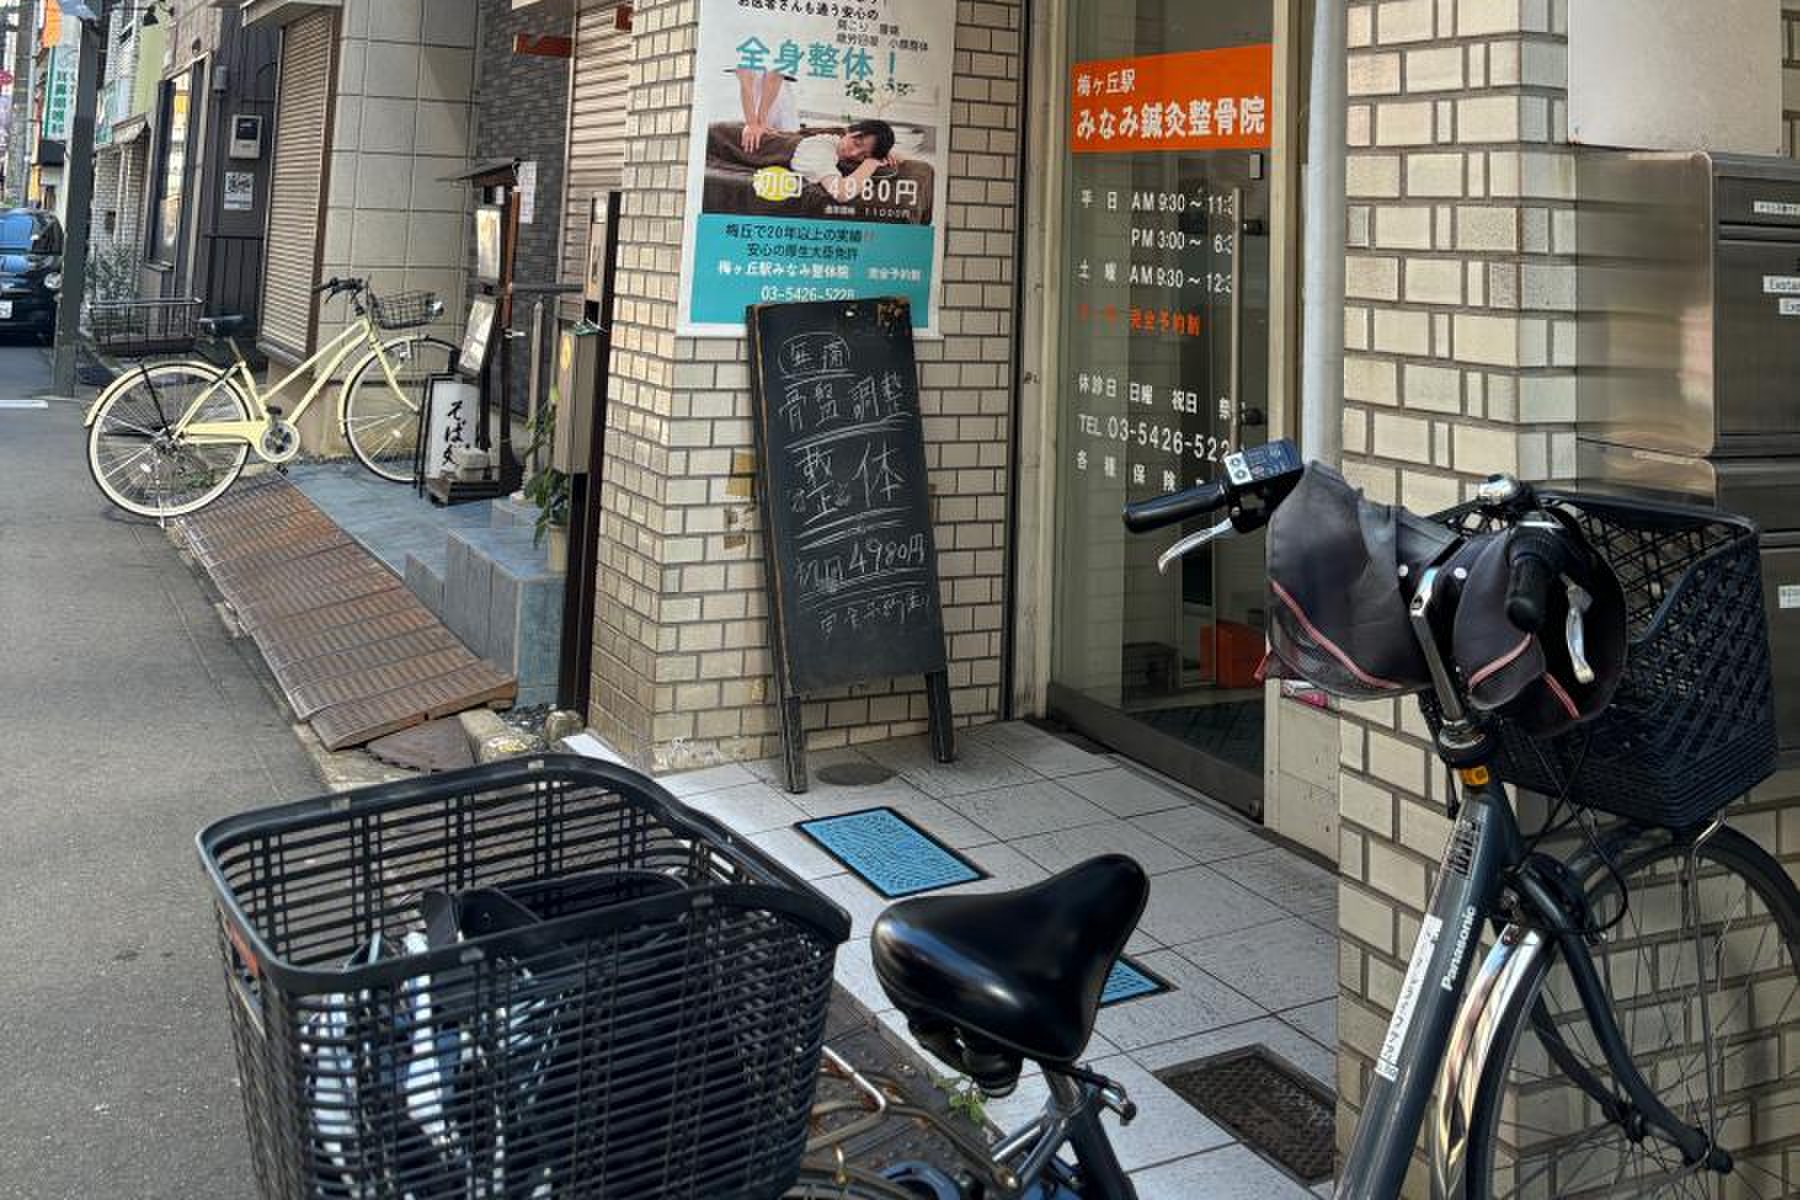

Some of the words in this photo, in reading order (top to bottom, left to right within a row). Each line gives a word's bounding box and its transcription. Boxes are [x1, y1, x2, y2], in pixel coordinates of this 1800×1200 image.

[1077, 96, 1265, 141] みなみ鍼灸整骨院
[829, 175, 918, 206] 4980円
[1107, 415, 1233, 464] 03-5426-522
[1441, 904, 1477, 991] Panasonic
